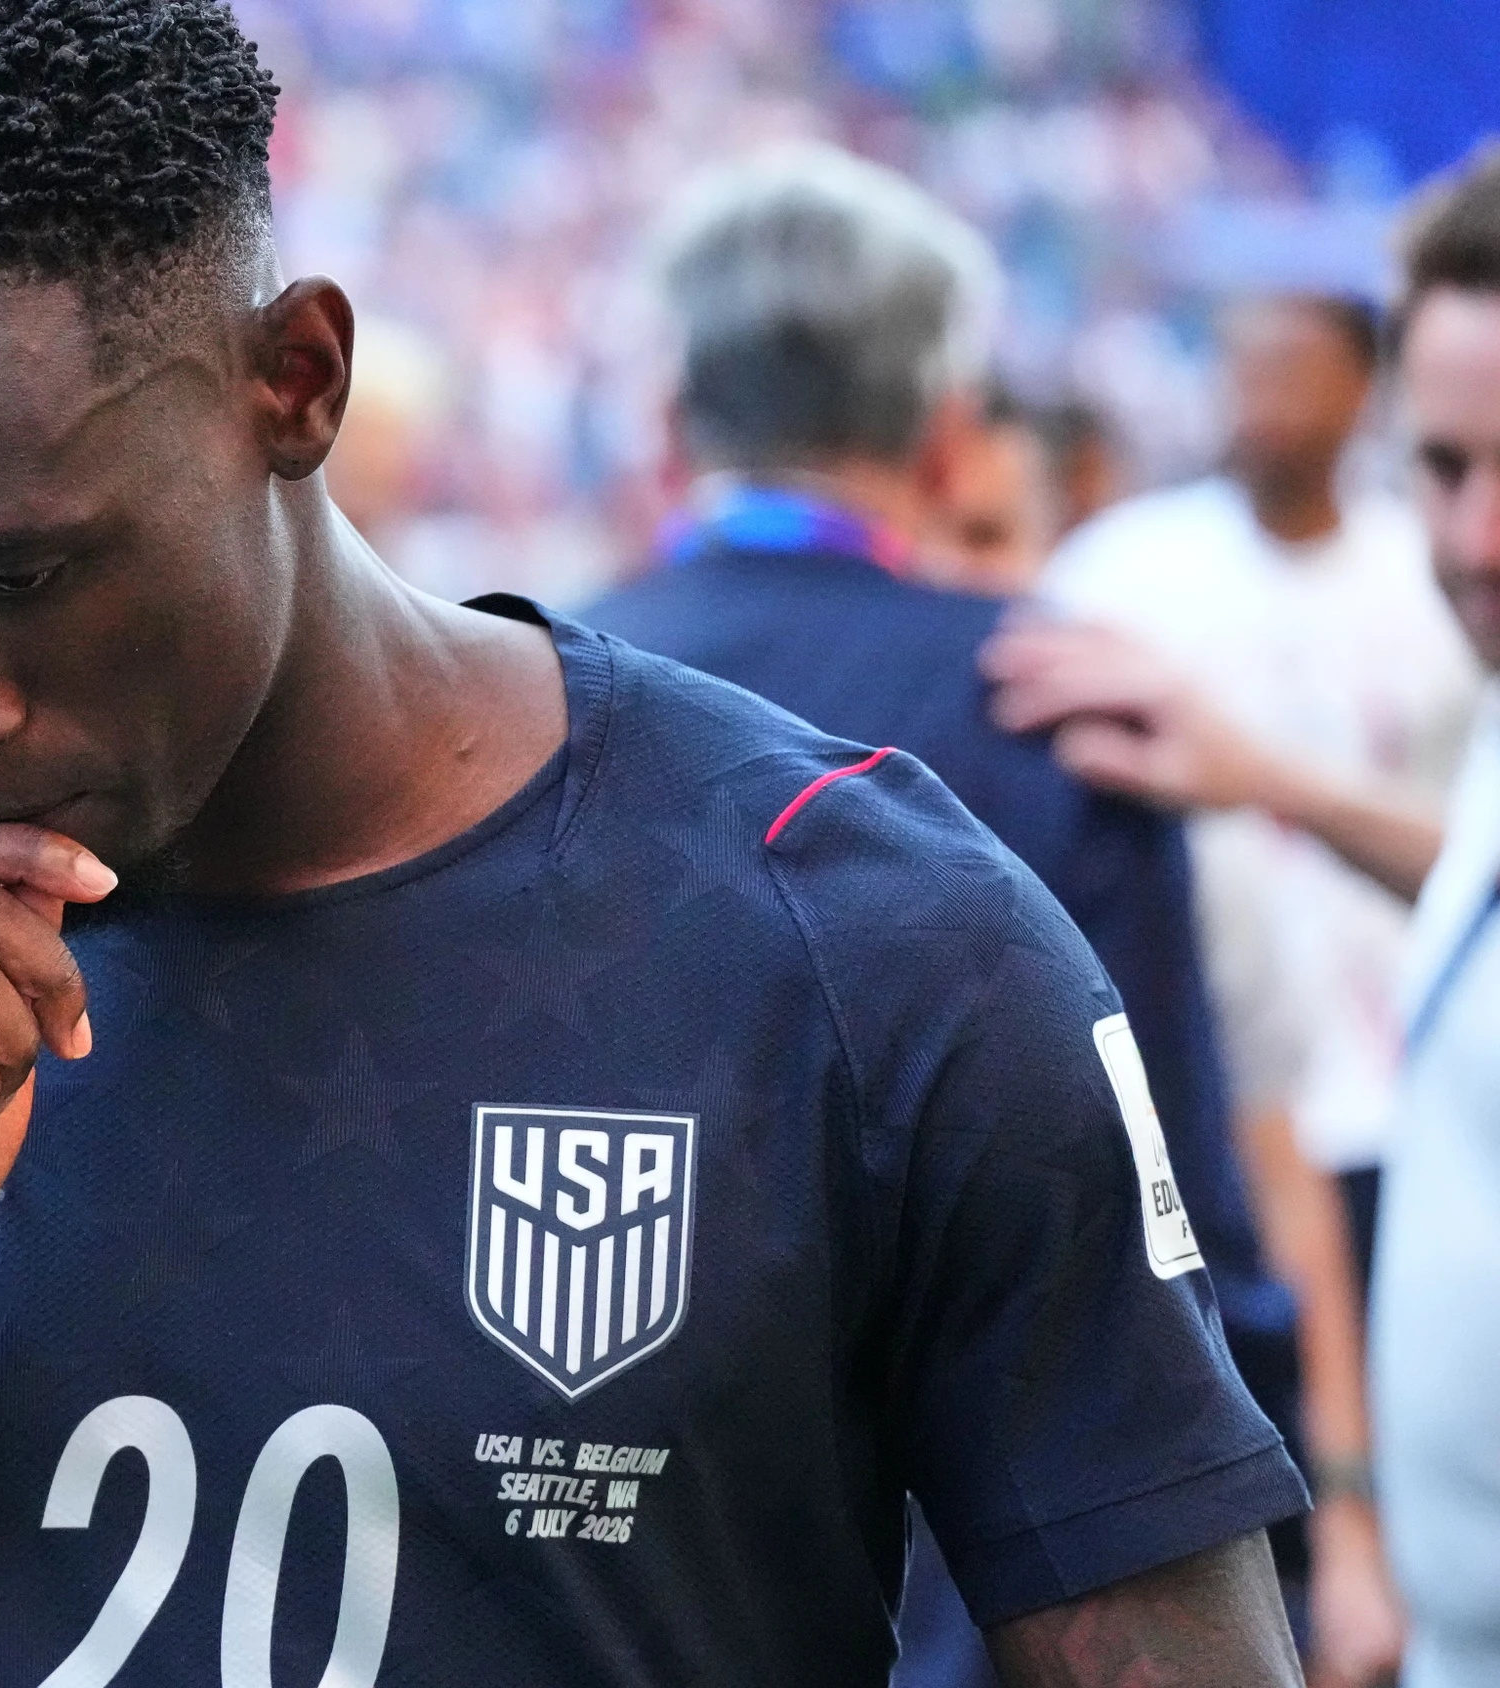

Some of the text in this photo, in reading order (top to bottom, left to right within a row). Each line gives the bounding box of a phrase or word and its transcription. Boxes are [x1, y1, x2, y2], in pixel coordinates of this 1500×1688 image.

[493, 1126, 674, 1231] USA
[474, 1433, 670, 1475] USA VS. BELGIUM
[497, 1472, 640, 1511] SEATTLE, WA
[37, 1395, 400, 1688] 20
[504, 1508, 635, 1544] 6 JULY 2026
